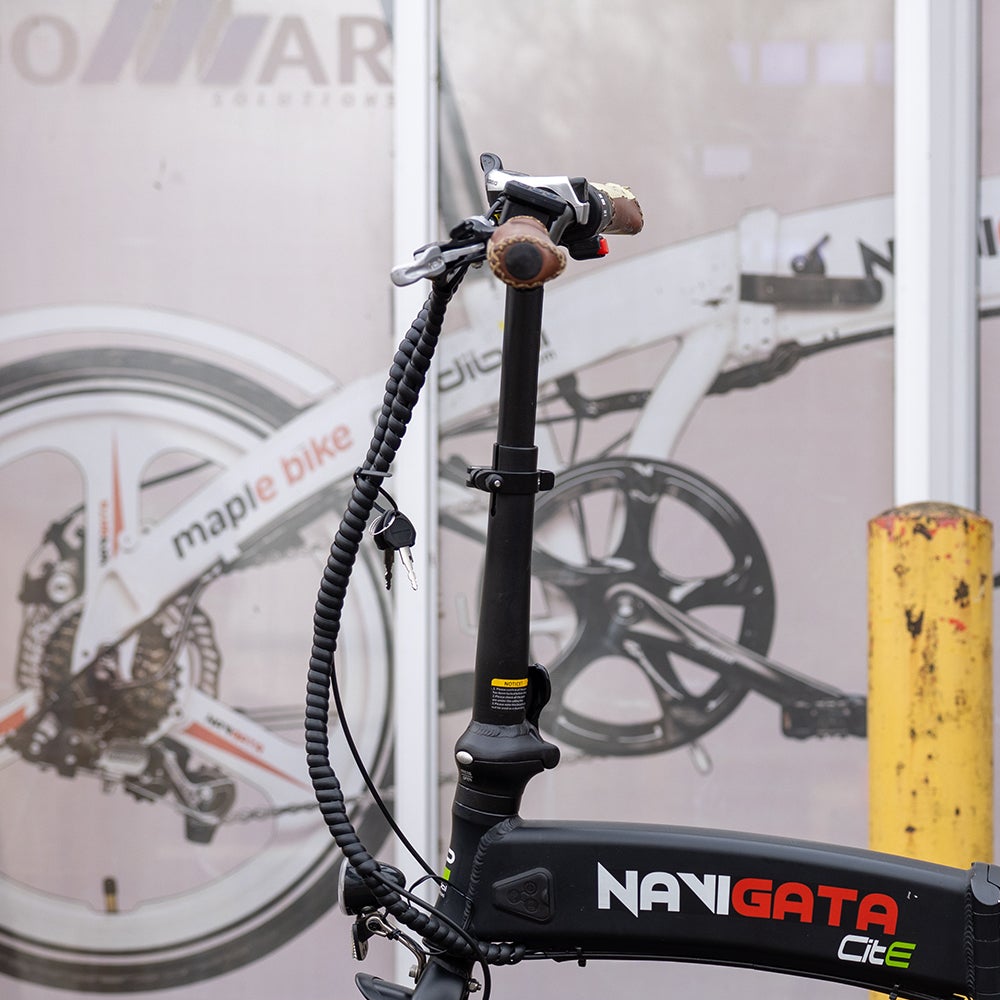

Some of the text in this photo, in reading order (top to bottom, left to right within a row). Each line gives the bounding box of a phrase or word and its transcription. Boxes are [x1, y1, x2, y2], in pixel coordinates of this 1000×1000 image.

[171, 475, 278, 559] maple
[280, 425, 354, 487] bike
[597, 861, 899, 935] NAVIGATA
[837, 934, 917, 969] CitE
